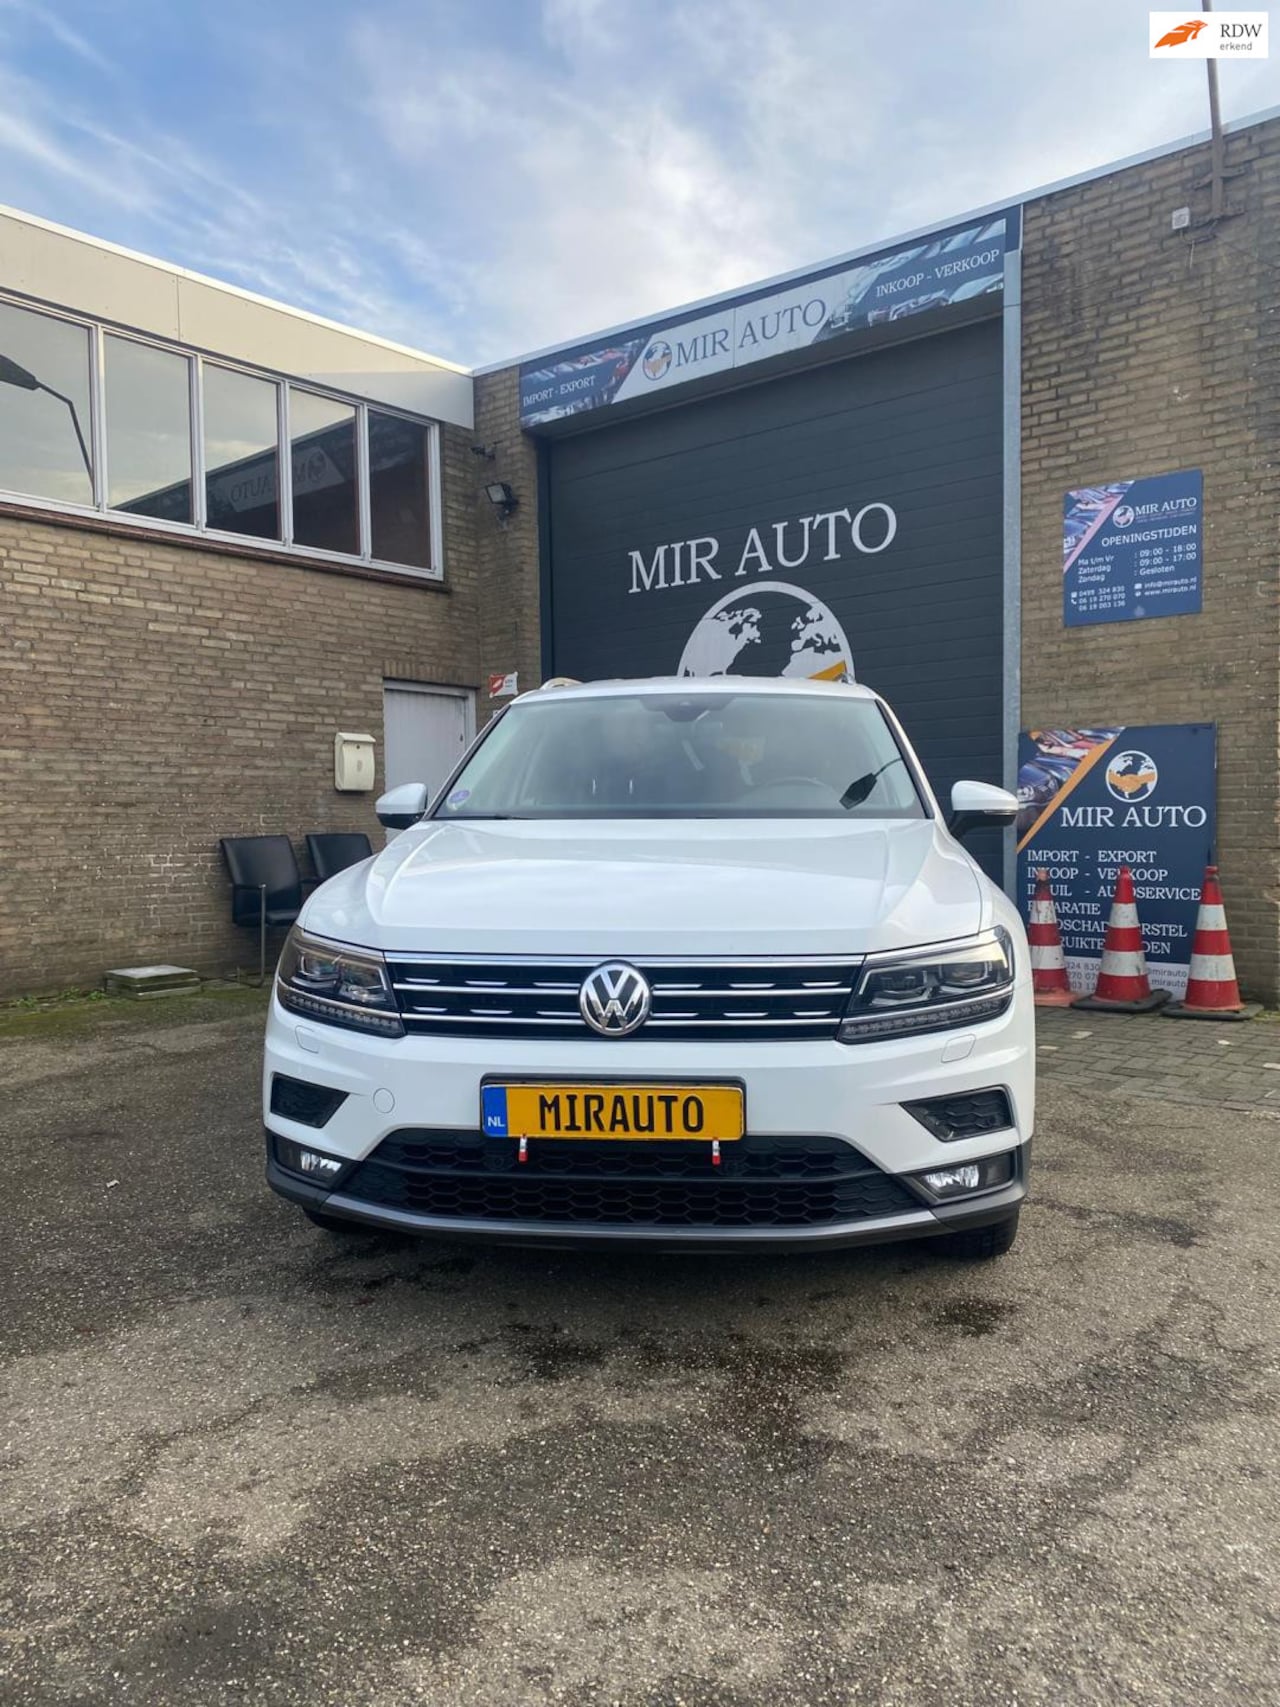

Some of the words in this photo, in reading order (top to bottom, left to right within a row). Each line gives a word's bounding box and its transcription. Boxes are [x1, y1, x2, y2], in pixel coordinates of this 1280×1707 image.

[875, 272, 925, 298] INKOOP
[934, 249, 1000, 280] VERKOOP
[675, 328, 731, 368] MIR
[738, 298, 827, 349] AUTO
[522, 387, 554, 408] IMPORT
[559, 375, 596, 396] EXPORT
[1135, 503, 1160, 516] MIR
[1161, 496, 1198, 512] AUTO
[1101, 524, 1197, 547] OPENINGSTIJDEN
[627, 536, 722, 594] MIR
[734, 502, 898, 577] AUTO
[1139, 547, 1163, 558] 09:00
[1173, 542, 1197, 554] 18:00
[1078, 565, 1112, 575] Zaterdag
[1139, 556, 1163, 567] 09:00
[1173, 551, 1197, 562] 17:00
[1078, 574, 1106, 584] Zondag
[1139, 565, 1175, 576] Gesloten
[1060, 806, 1116, 828] MIR
[1121, 805, 1207, 828] AUTO
[1027, 849, 1080, 863] IMPORT
[1098, 850, 1157, 864] EXPORT
[1097, 867, 1168, 882] VEKOOP
[1027, 883, 1073, 897] IUIL
[1097, 885, 1202, 901] AUSERVICE
[1027, 900, 1101, 915] ARATIE
[1148, 967, 1187, 978] mirauto
[487, 1116, 505, 1128] NL
[538, 1093, 705, 1133] MIRAUTO
